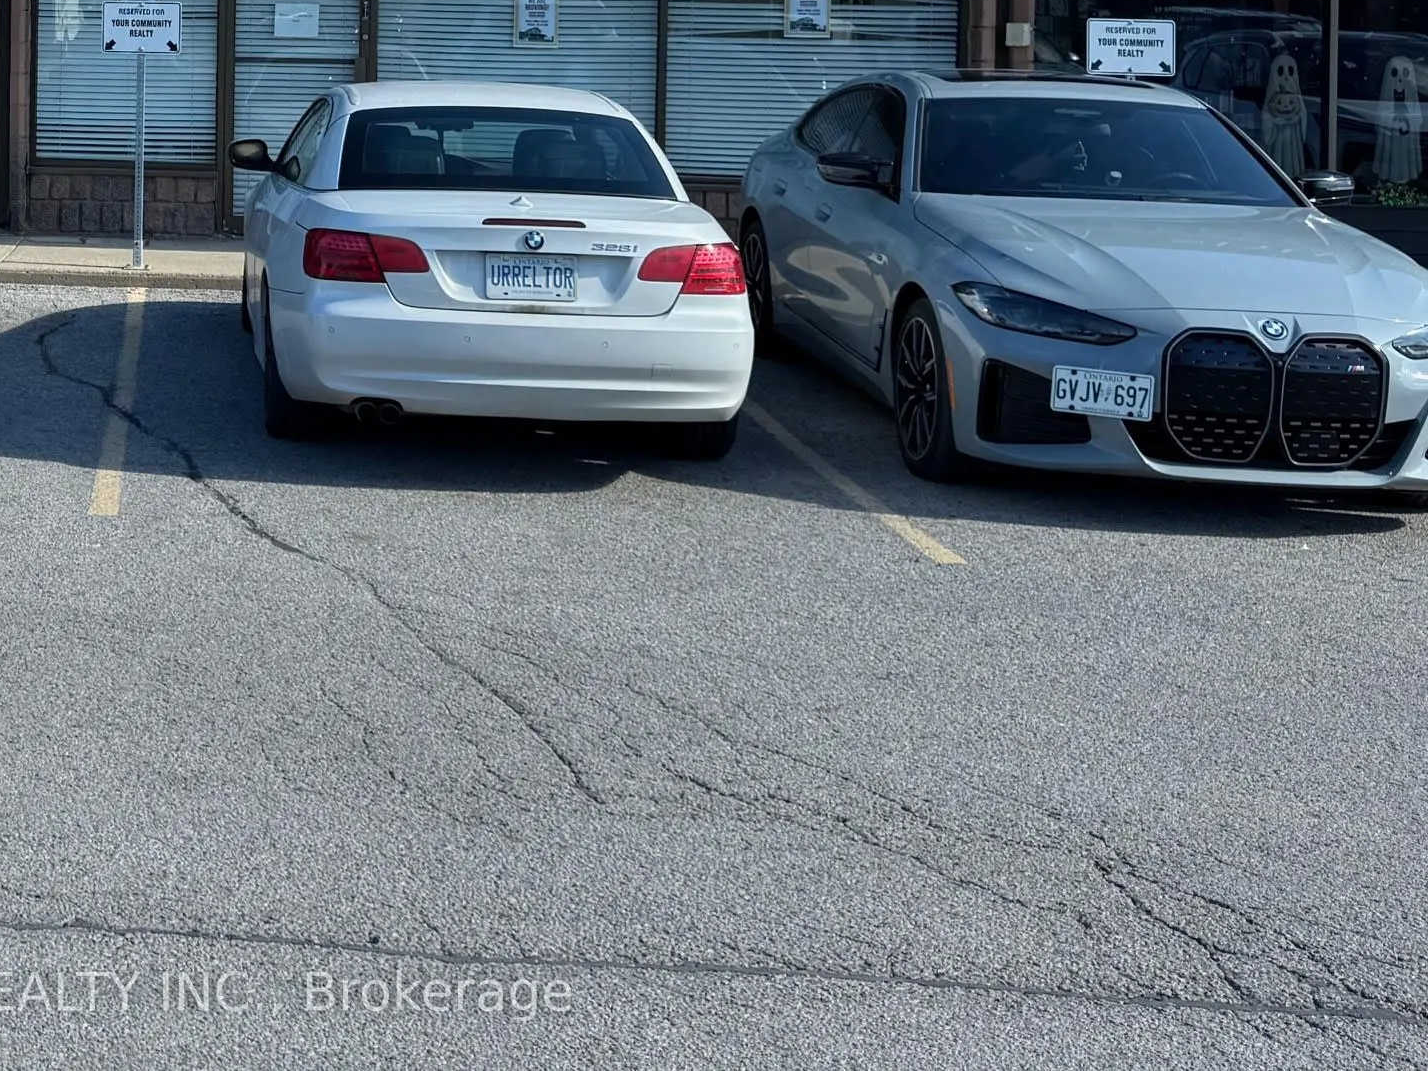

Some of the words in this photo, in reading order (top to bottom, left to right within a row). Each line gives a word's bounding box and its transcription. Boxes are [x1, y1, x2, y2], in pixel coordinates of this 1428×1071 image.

[152, 8, 165, 16] FOR
[112, 19, 129, 27] YOUR
[131, 19, 172, 28] COMMUNITY
[129, 29, 154, 38] REALTY
[1105, 26, 1141, 34] RESERVED
[1142, 27, 1156, 35] FOR
[1098, 38, 1117, 46] YOUR
[1119, 38, 1164, 48] COMMUNITY
[1117, 49, 1144, 57] REALTY
[1084, 372, 1123, 383] ONTARIO
[1056, 377, 1102, 404] GVJV
[1114, 384, 1149, 409] 697
